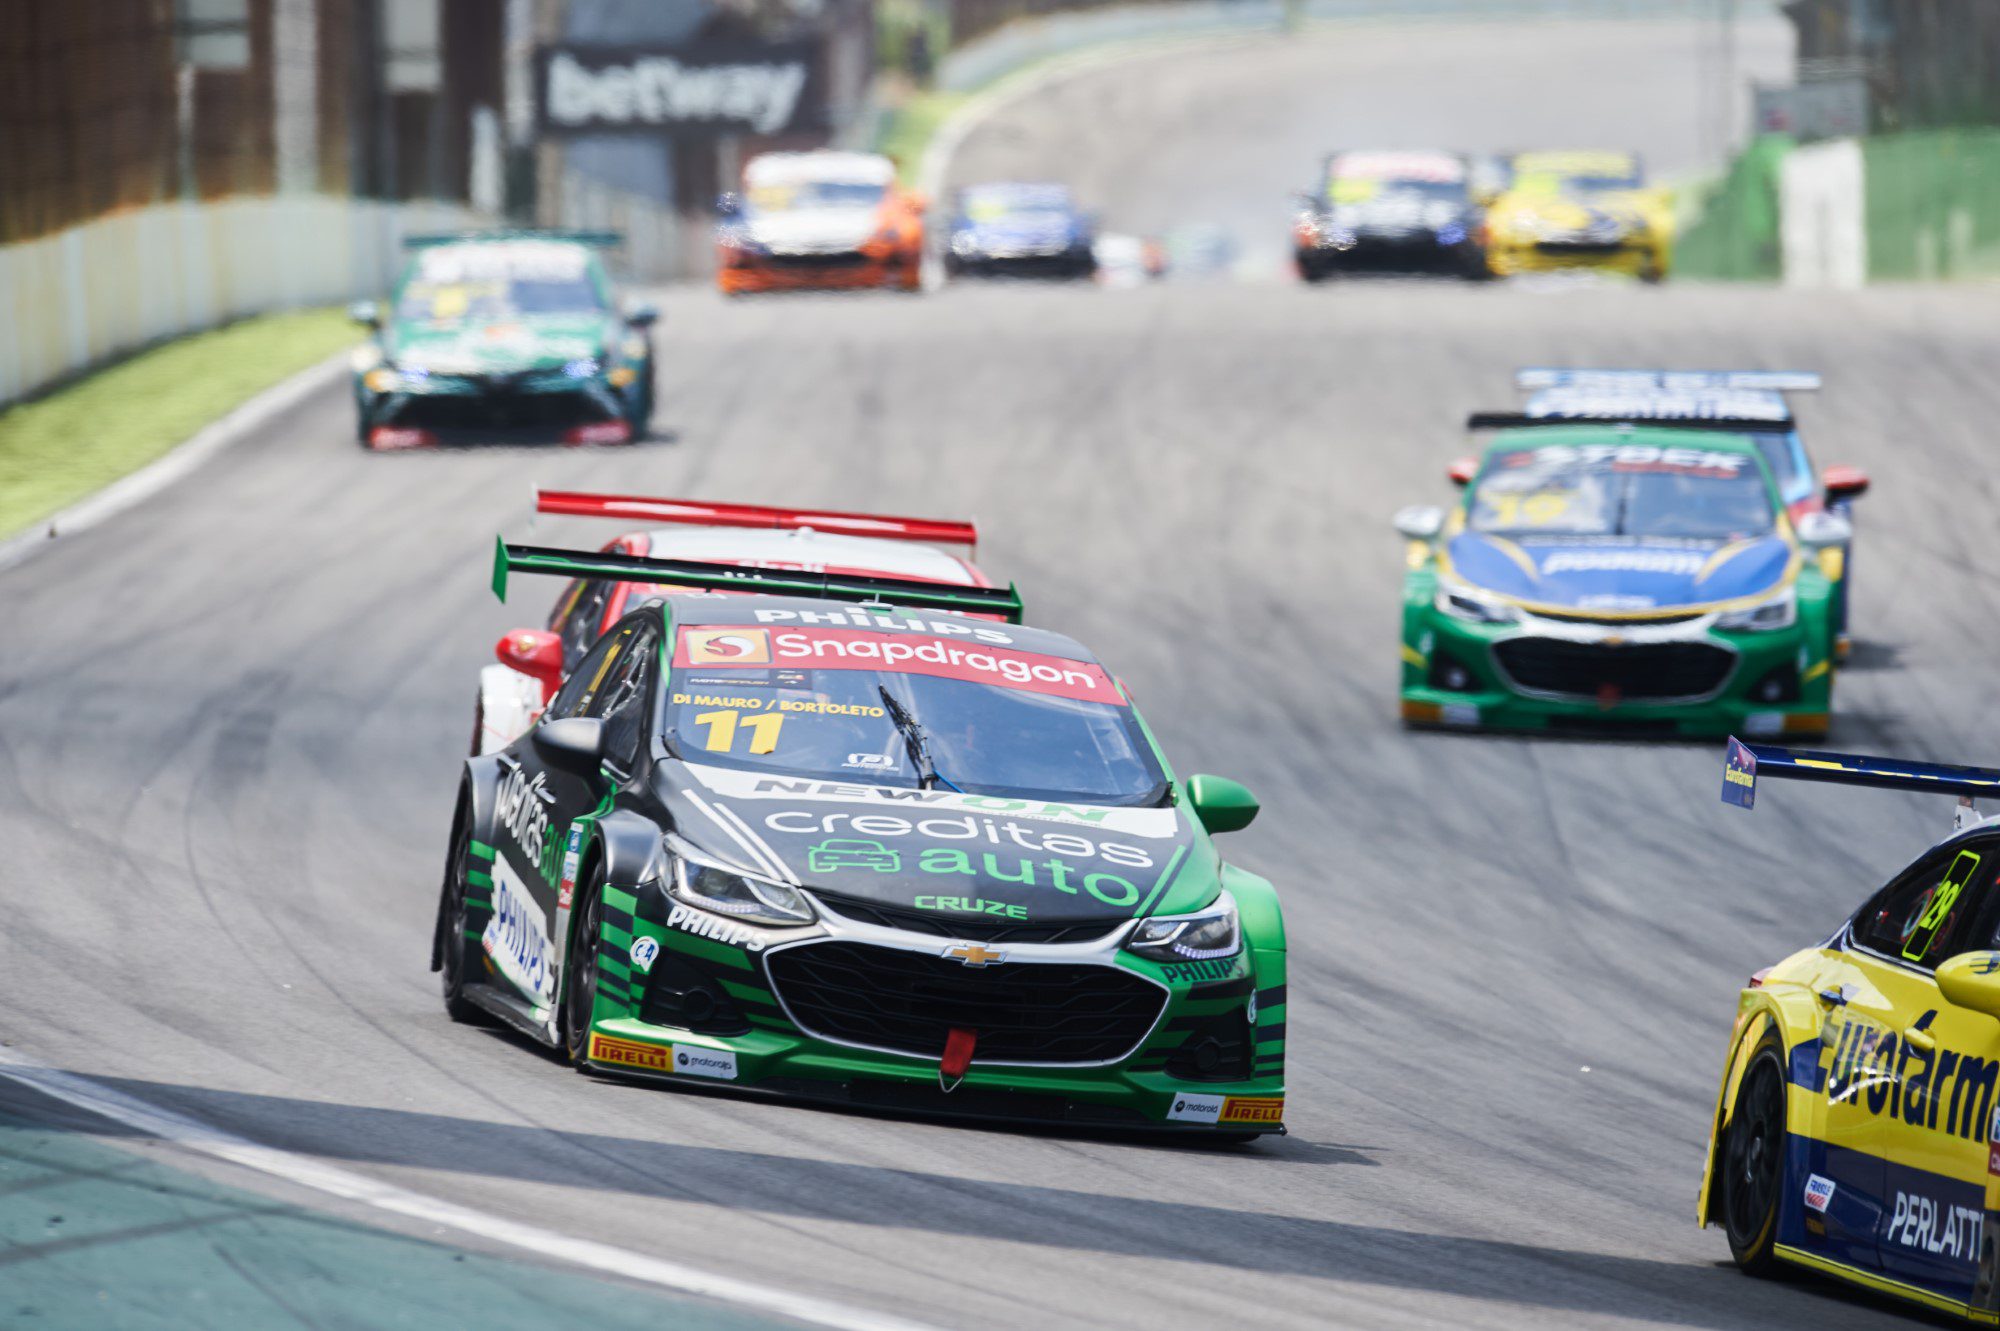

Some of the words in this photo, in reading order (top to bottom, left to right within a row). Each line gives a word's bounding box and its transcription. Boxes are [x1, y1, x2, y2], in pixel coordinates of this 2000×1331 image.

[548, 51, 806, 133] betway
[754, 607, 1014, 645] PHILIPS
[776, 633, 1096, 688] Snapdragon
[673, 693, 691, 704] DI
[694, 695, 762, 709] MAURO
[765, 699, 775, 710] /
[780, 701, 884, 717] BORTOLETO
[695, 710, 785, 754] 11
[765, 811, 1153, 867] creditas
[918, 847, 1140, 906] auto
[914, 895, 1028, 920] CRUZE
[1919, 880, 1960, 931] 29
[498, 879, 546, 992] PHILIPS
[666, 905, 770, 952] PHILIPS
[1160, 957, 1246, 983] PHILIPS
[593, 1036, 668, 1069] PIRELLI
[1185, 1102, 1219, 1114] motorola
[1224, 1099, 1285, 1120] PIRELLI
[1887, 1189, 1985, 1263] PERLATTI
